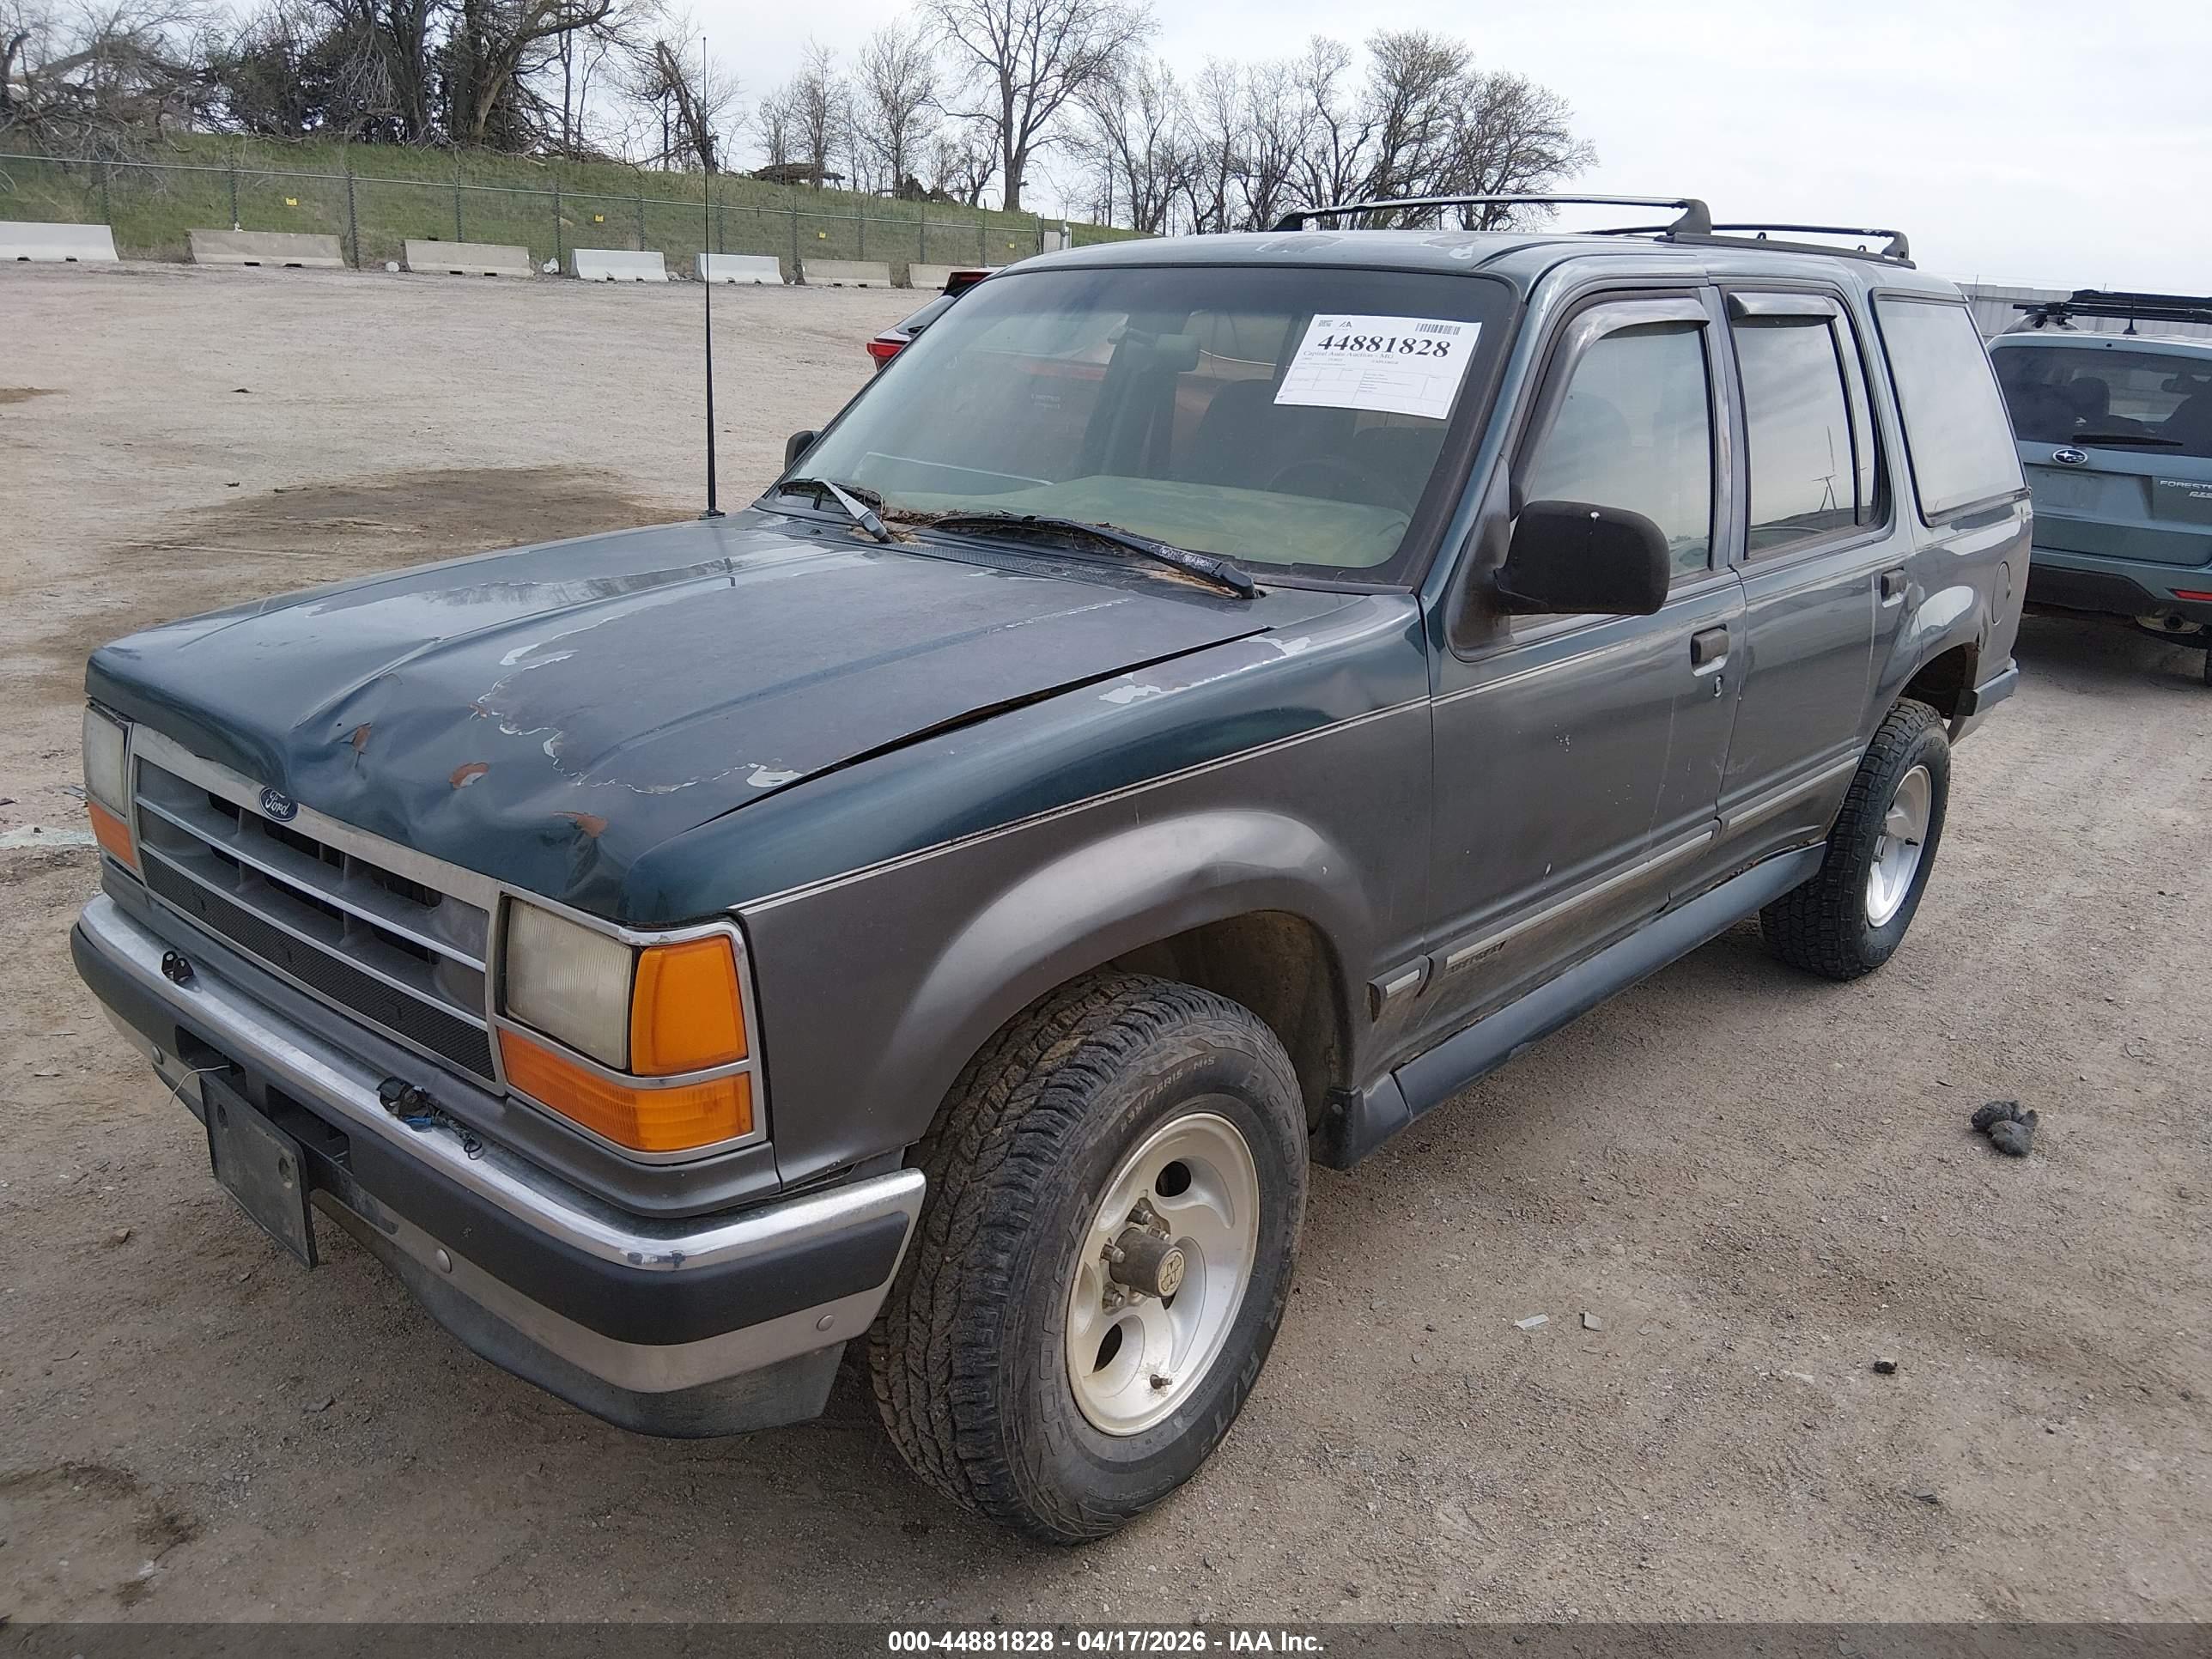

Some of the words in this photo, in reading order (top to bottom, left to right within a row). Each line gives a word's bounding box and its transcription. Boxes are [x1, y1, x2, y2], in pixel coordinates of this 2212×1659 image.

[1317, 334, 1451, 358] 44881828
[264, 790, 291, 817] Ford
[1037, 1192, 1091, 1457] COOPER
